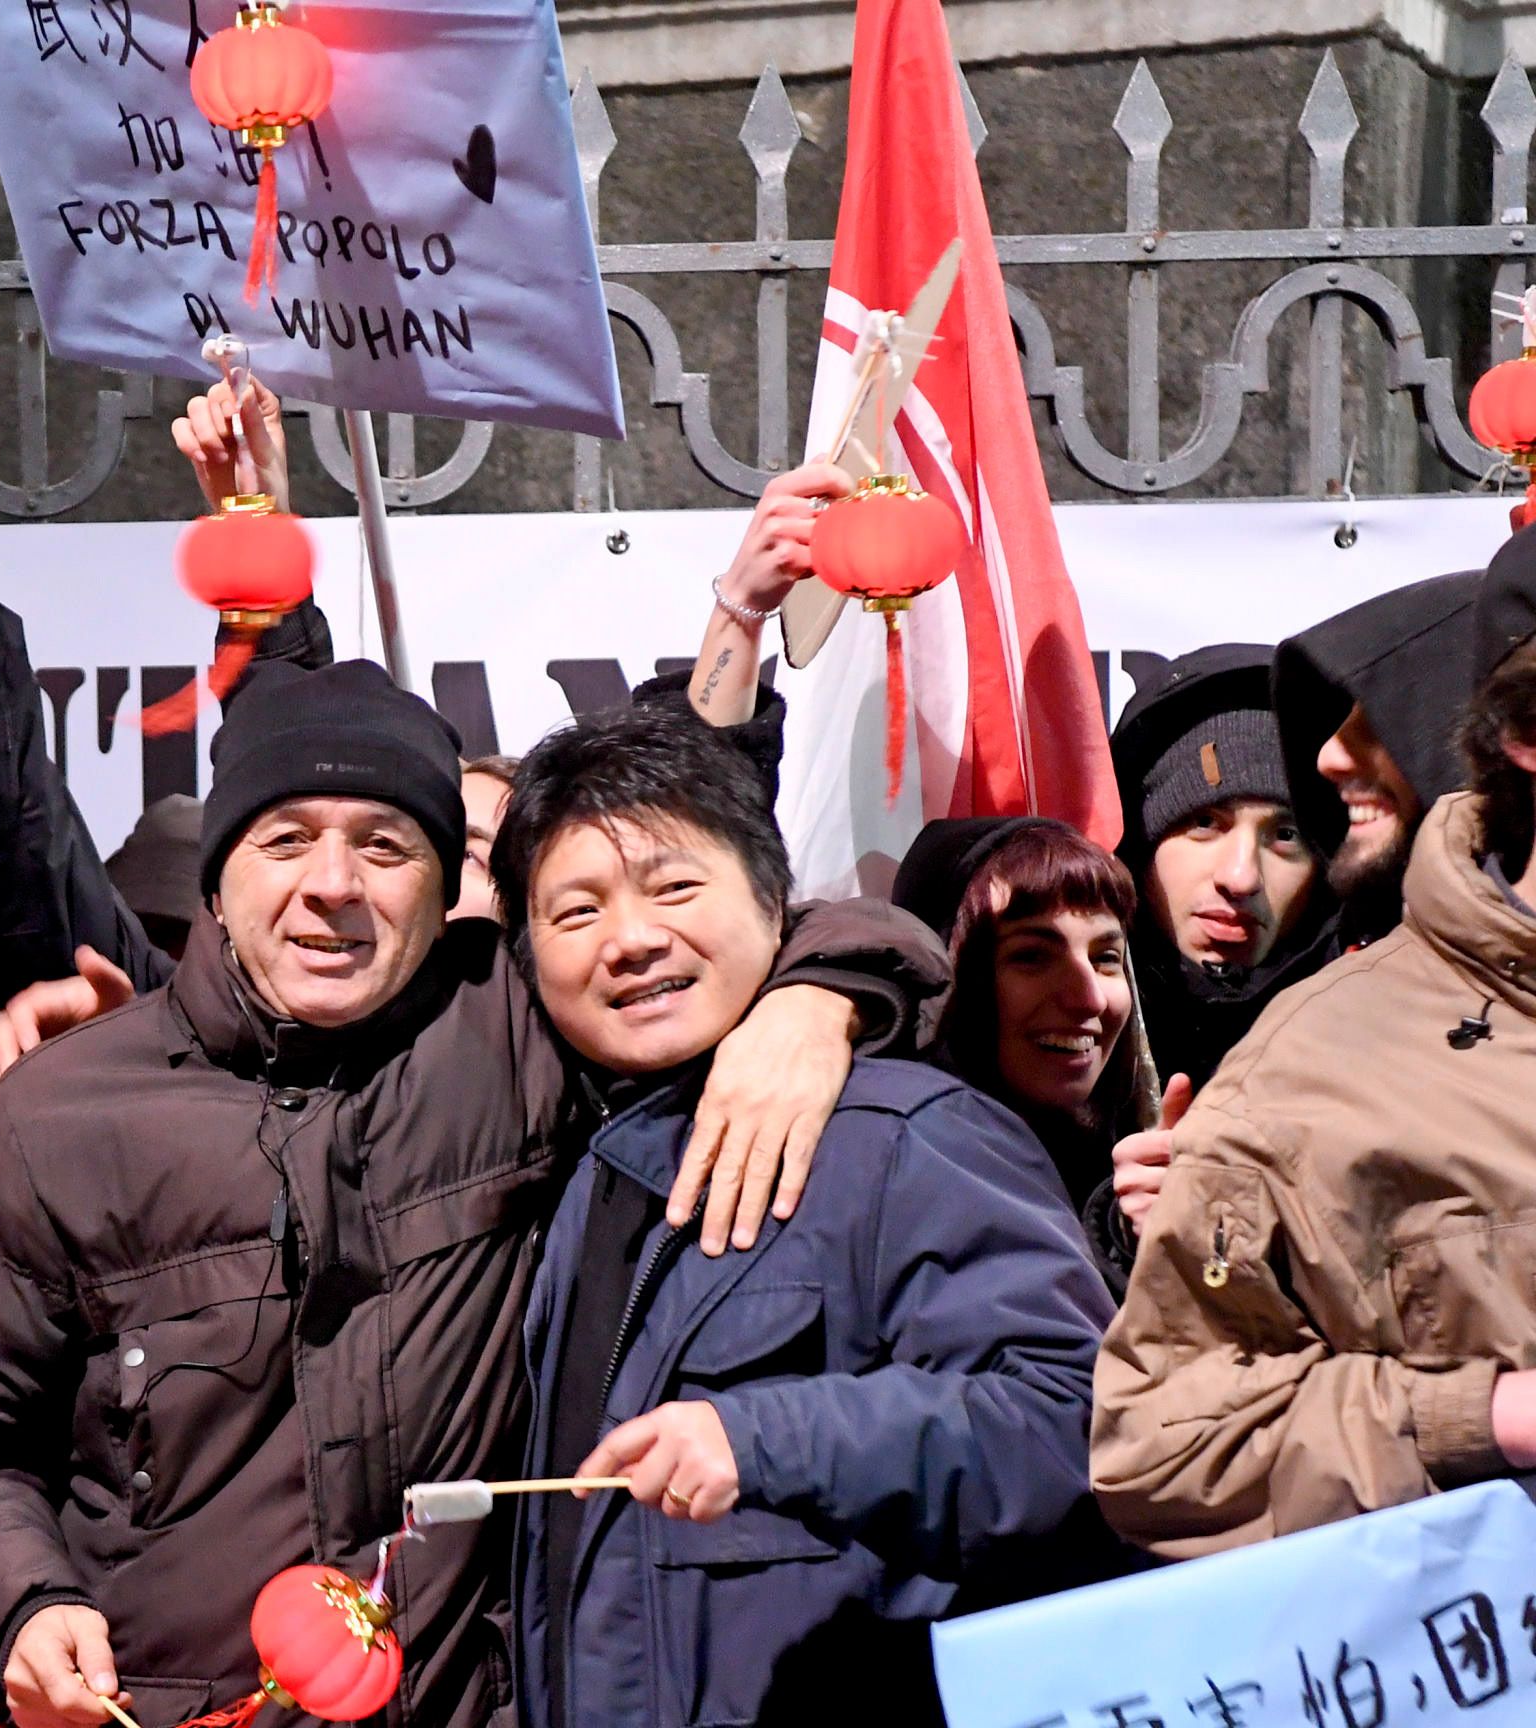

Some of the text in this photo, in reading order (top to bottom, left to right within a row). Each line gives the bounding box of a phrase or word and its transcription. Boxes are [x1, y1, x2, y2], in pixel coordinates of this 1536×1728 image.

[58, 200, 457, 280] FORZA POPOLO
[182, 292, 475, 361] DI WUHAN
